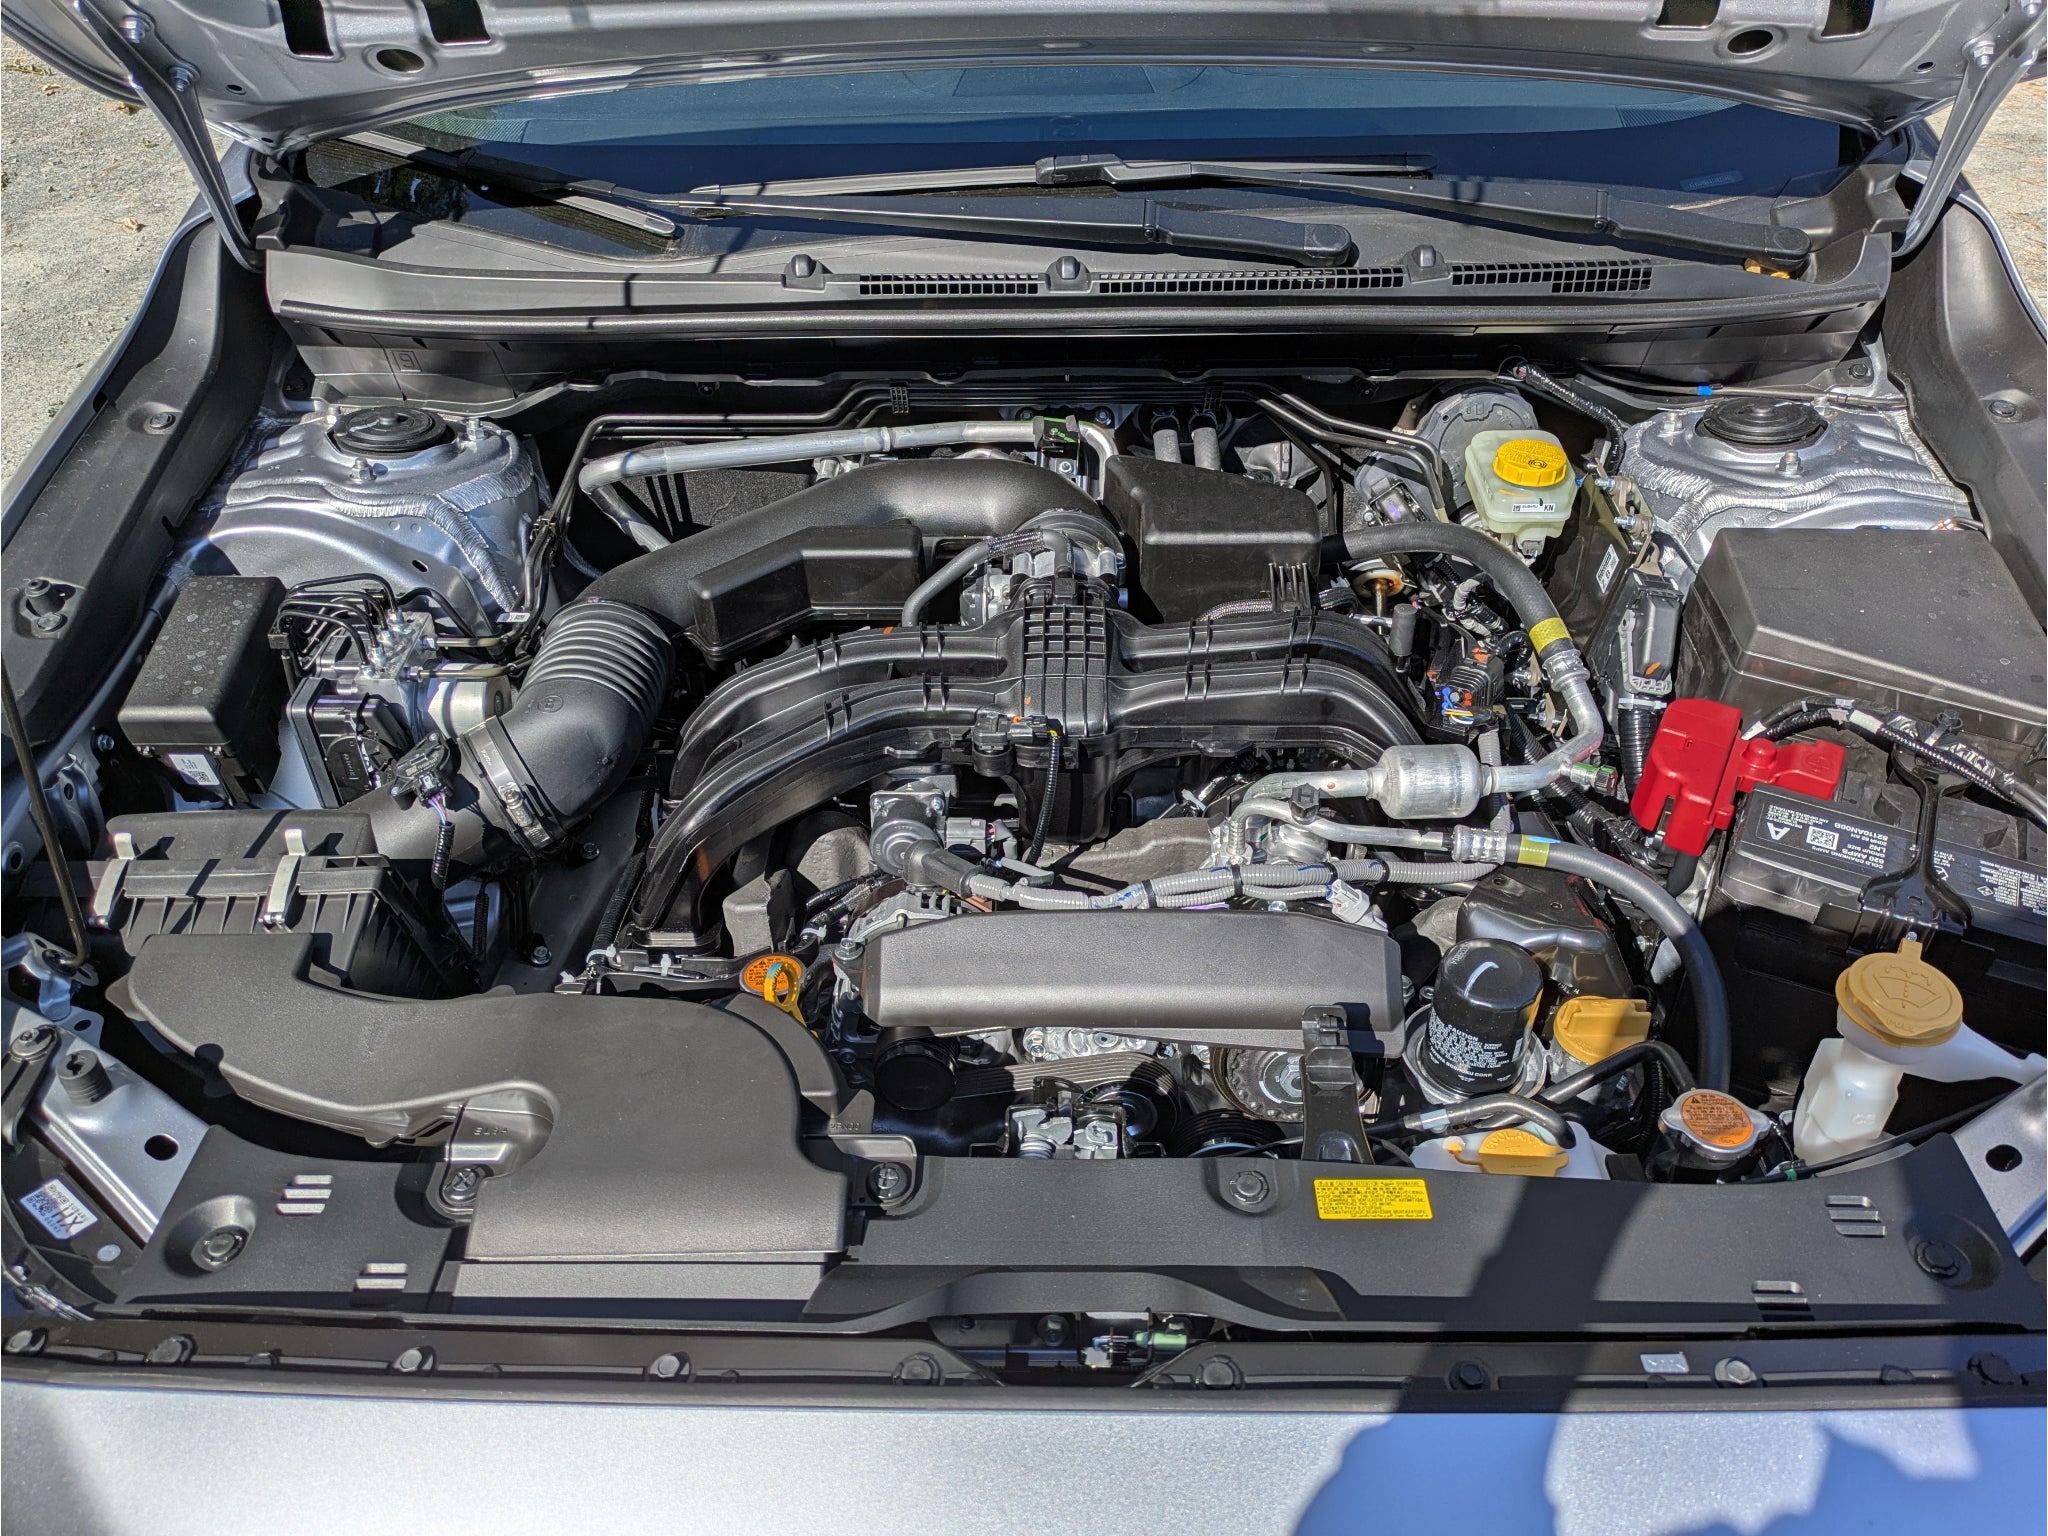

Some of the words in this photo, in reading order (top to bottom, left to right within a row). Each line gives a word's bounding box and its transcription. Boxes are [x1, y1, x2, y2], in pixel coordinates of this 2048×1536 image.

[1544, 504, 1554, 512] KN
[1811, 845, 1830, 854] AMPS
[1847, 843, 1862, 851] SIZE
[1868, 843, 1886, 854] LN2
[1830, 850, 1865, 864] CRANKING
[1842, 848, 1868, 860] AMPS
[1861, 848, 1886, 858] GROUP
[1865, 860, 1884, 869] COLD
[1448, 1024, 1479, 1042] CAUTION
[51, 1206, 84, 1233] HX
